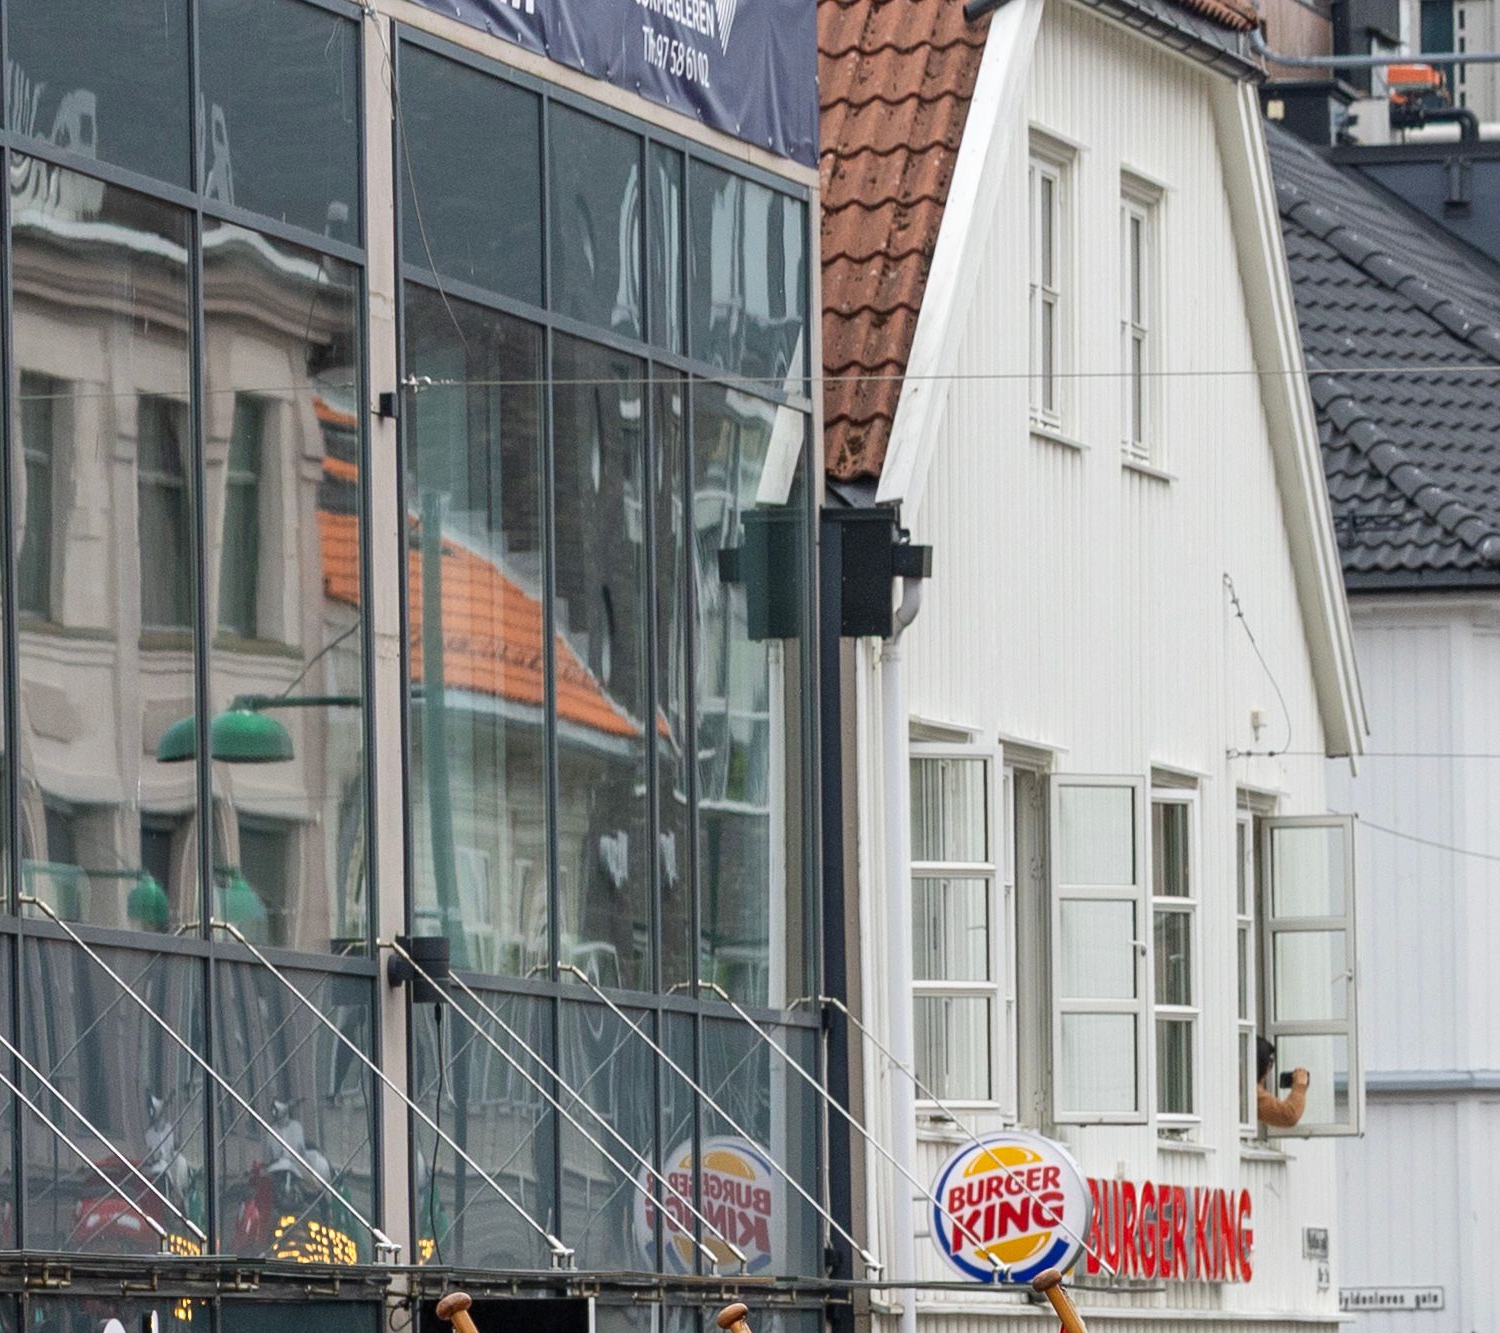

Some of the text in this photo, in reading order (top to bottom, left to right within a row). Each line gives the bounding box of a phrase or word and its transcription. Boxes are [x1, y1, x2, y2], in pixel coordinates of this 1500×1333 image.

[636, 0, 715, 38] MEGLEREN
[657, 34, 669, 70] 97
[670, 40, 685, 77] 58
[686, 46, 697, 82] 61
[698, 51, 710, 88] 02
[948, 1166, 1061, 1213] BURGER
[950, 1192, 1064, 1254] KING
[1085, 1178, 1254, 1283] BURGER KING
